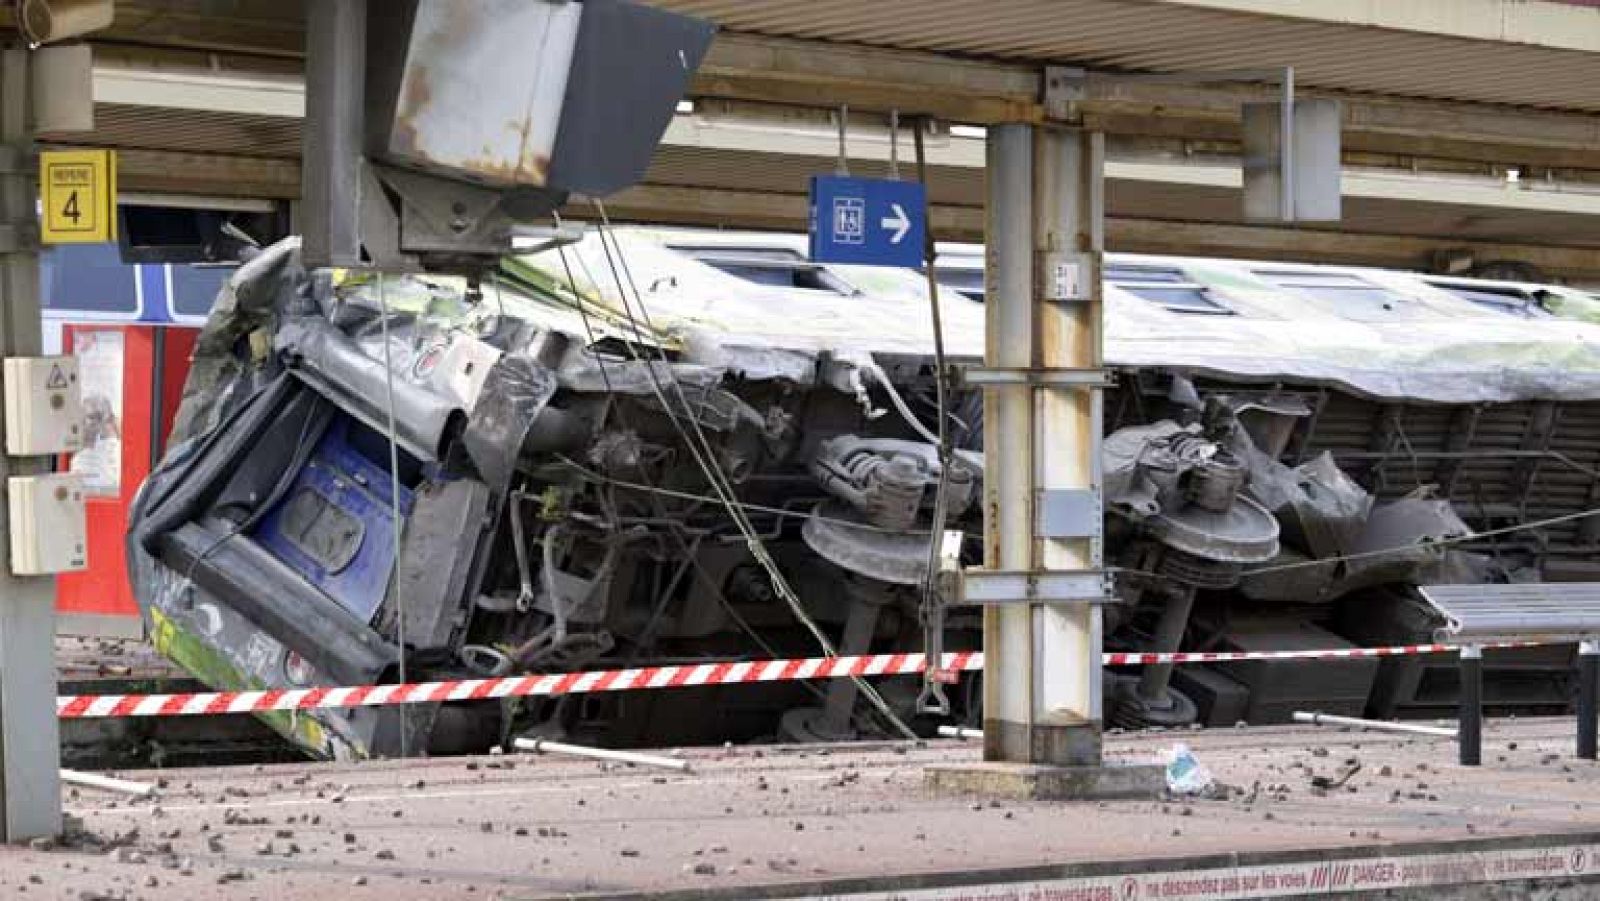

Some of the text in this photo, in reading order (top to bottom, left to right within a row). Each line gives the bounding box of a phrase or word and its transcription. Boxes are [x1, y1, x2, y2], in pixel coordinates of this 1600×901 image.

[62, 190, 81, 224] 4
[1162, 877, 1217, 896] descendez
[1220, 877, 1239, 894] pas
[1243, 875, 1259, 890] sur
[1262, 871, 1277, 888] les
[1280, 873, 1306, 888] voies
[1353, 863, 1395, 884] DANGER
